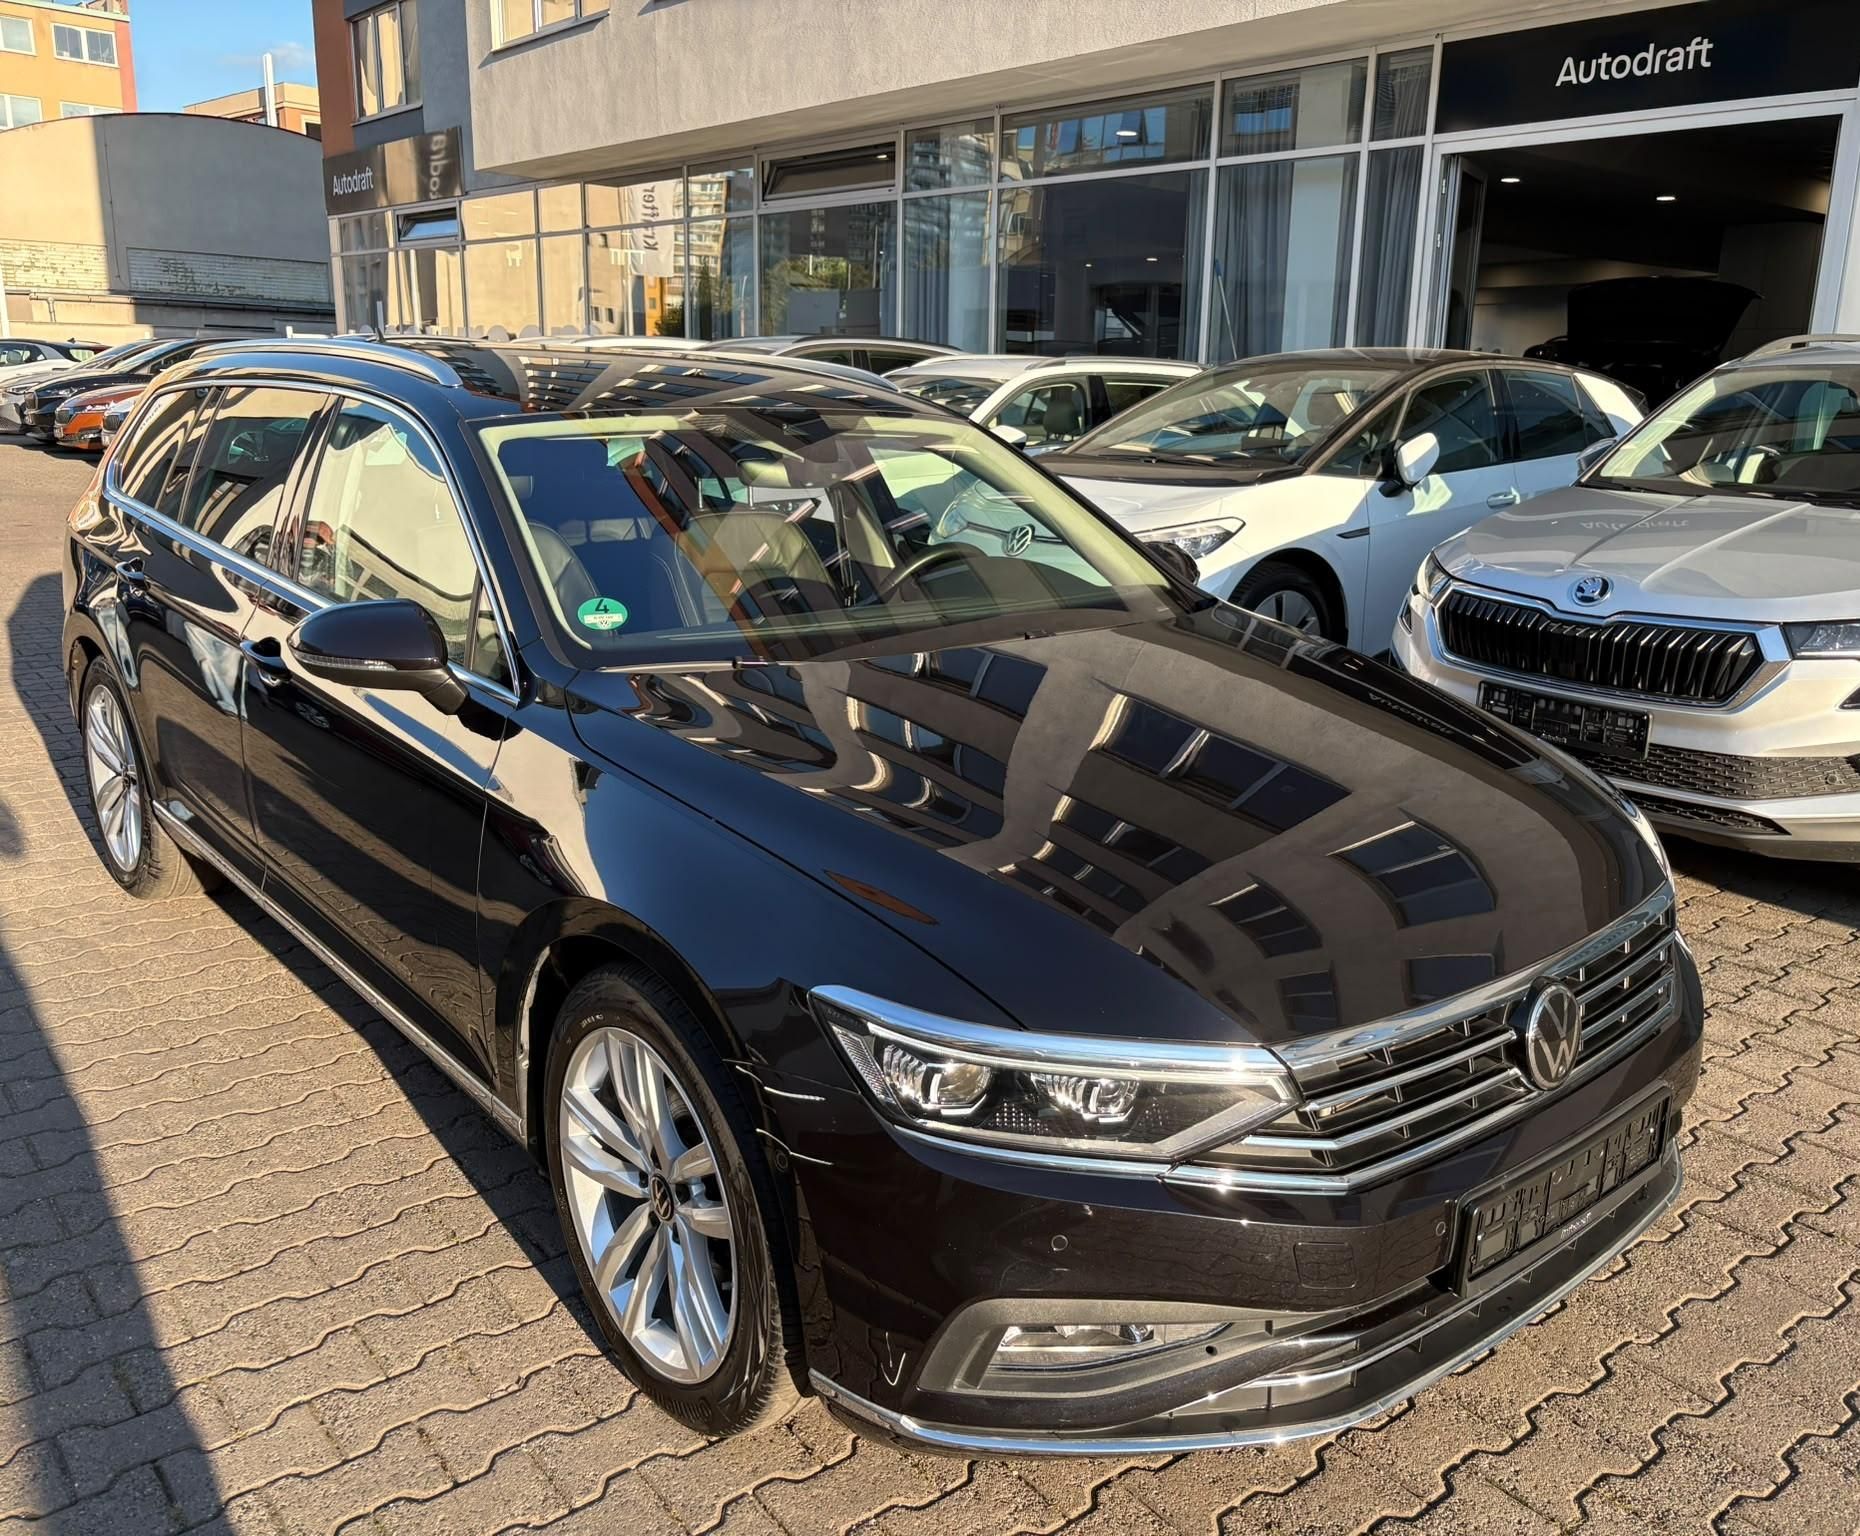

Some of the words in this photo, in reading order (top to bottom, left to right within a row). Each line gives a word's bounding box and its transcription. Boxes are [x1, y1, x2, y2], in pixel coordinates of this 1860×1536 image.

[1555, 37, 1714, 87] Autodraft
[332, 166, 374, 196] Autodraft
[595, 599, 610, 614] 4
[1528, 985, 1579, 1088] VW
